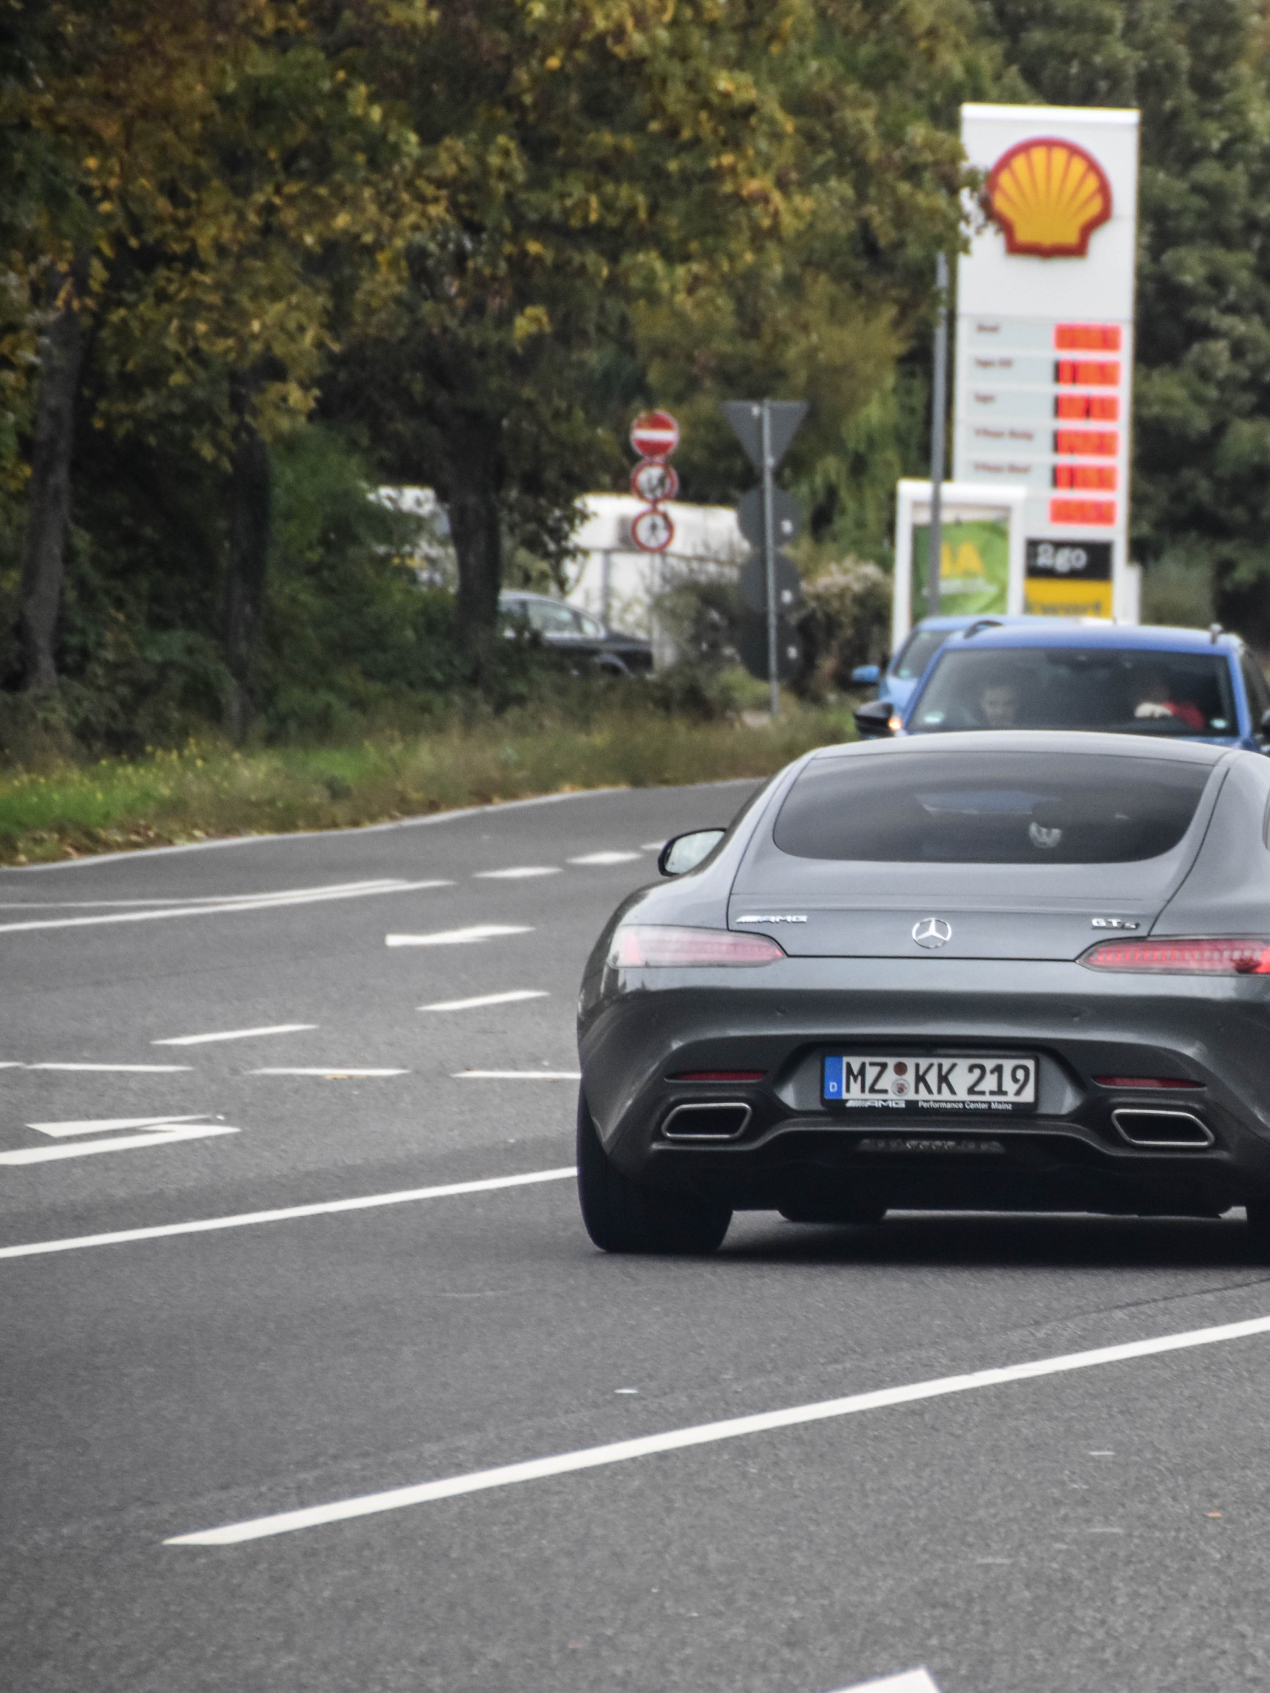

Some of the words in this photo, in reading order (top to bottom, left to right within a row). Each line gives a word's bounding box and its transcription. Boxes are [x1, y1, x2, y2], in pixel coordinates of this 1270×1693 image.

[845, 1061, 889, 1095] MZ
[914, 1062, 958, 1096] KK
[966, 1063, 1031, 1097] 219
[829, 1081, 838, 1093] D
[864, 1099, 906, 1109] AMG
[918, 1100, 964, 1110] Performance
[965, 1100, 989, 1110] Center
[990, 1101, 1013, 1111] Mainz
